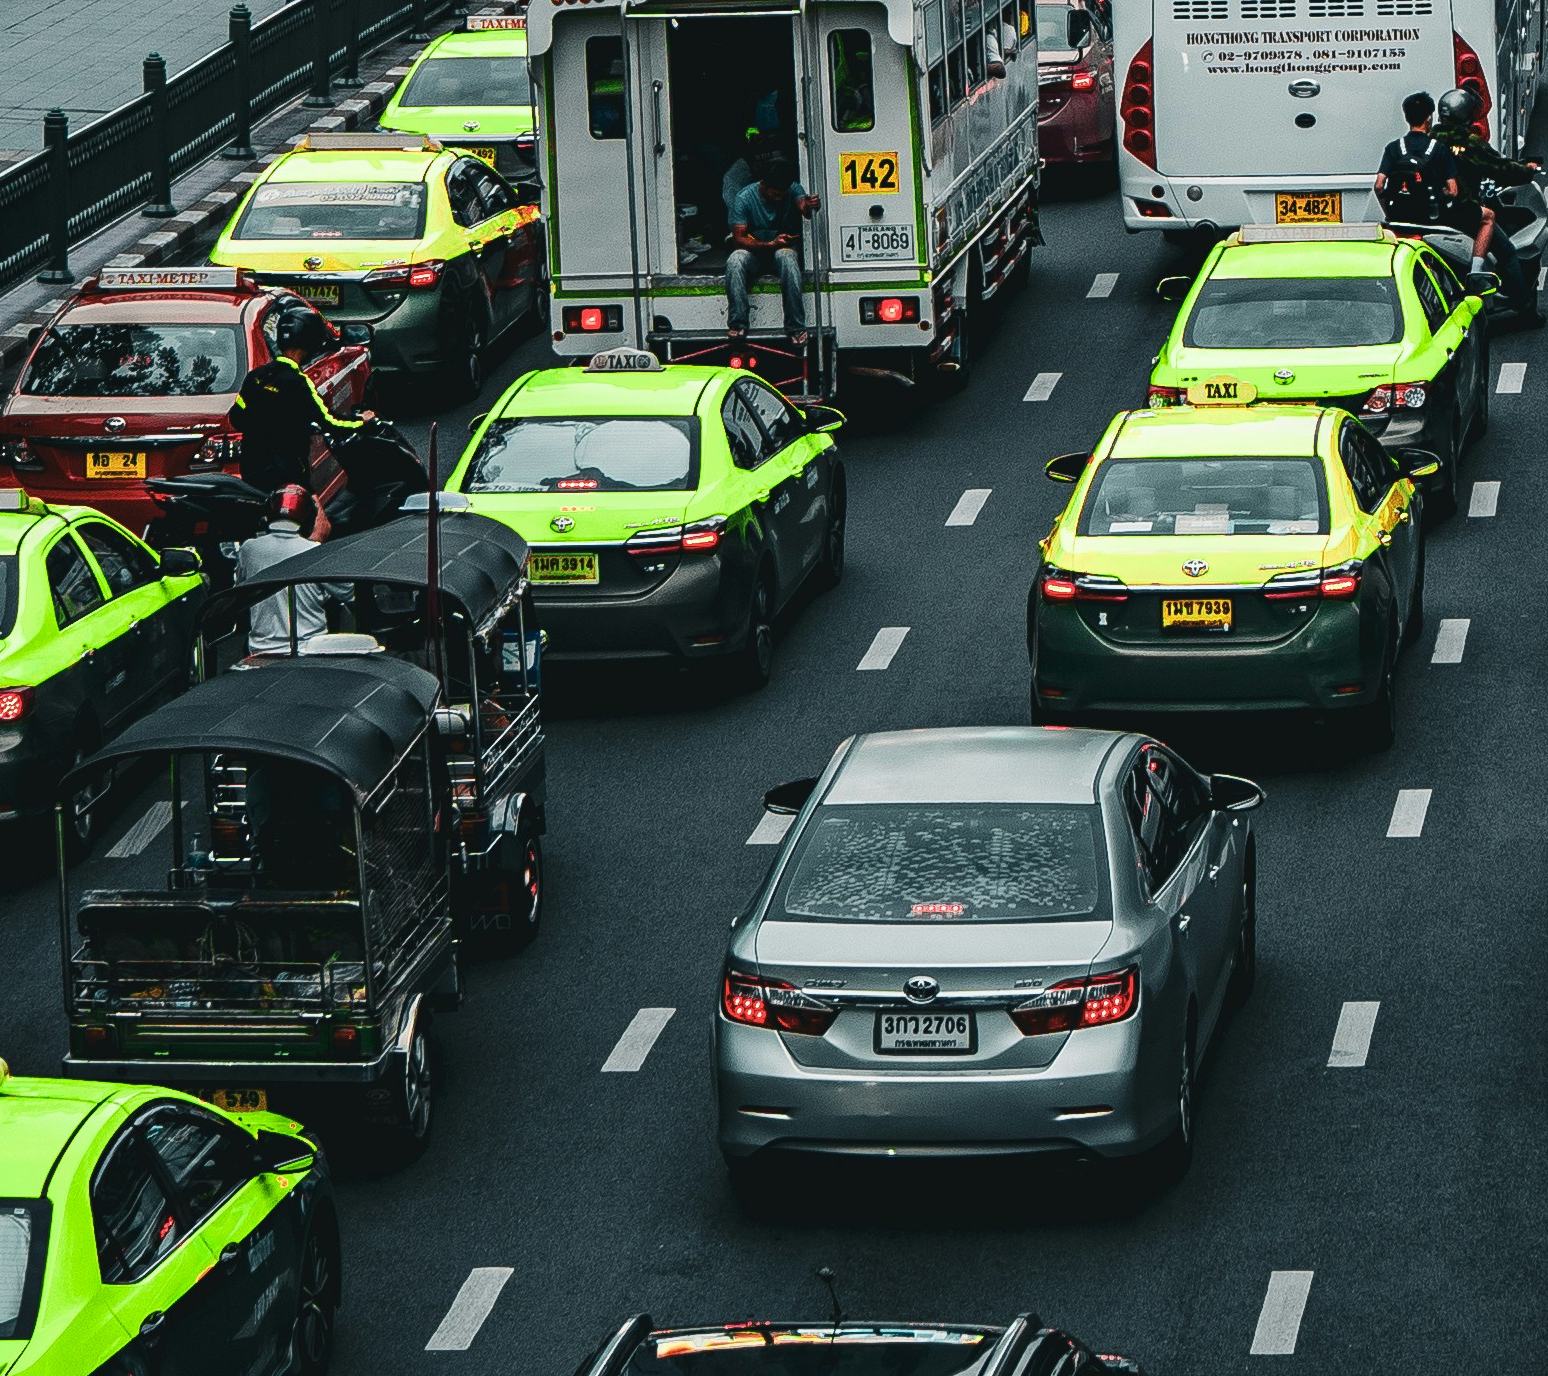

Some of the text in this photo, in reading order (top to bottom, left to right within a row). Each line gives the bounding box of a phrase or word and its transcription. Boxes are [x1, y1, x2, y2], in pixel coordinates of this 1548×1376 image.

[1186, 28, 1420, 46] HONGTHONG TRANSPORT CORPORATION
[1207, 61, 1401, 75] www.hongthonggroup.com
[845, 158, 896, 189] 142
[1281, 199, 1335, 216] 34-4821
[117, 272, 208, 286] TAXI-METER
[608, 355, 636, 369] TAXI
[1204, 382, 1238, 399] TAXI
[563, 556, 594, 573] 3914
[1194, 600, 1230, 615] 7939
[923, 1016, 967, 1034] 2706
